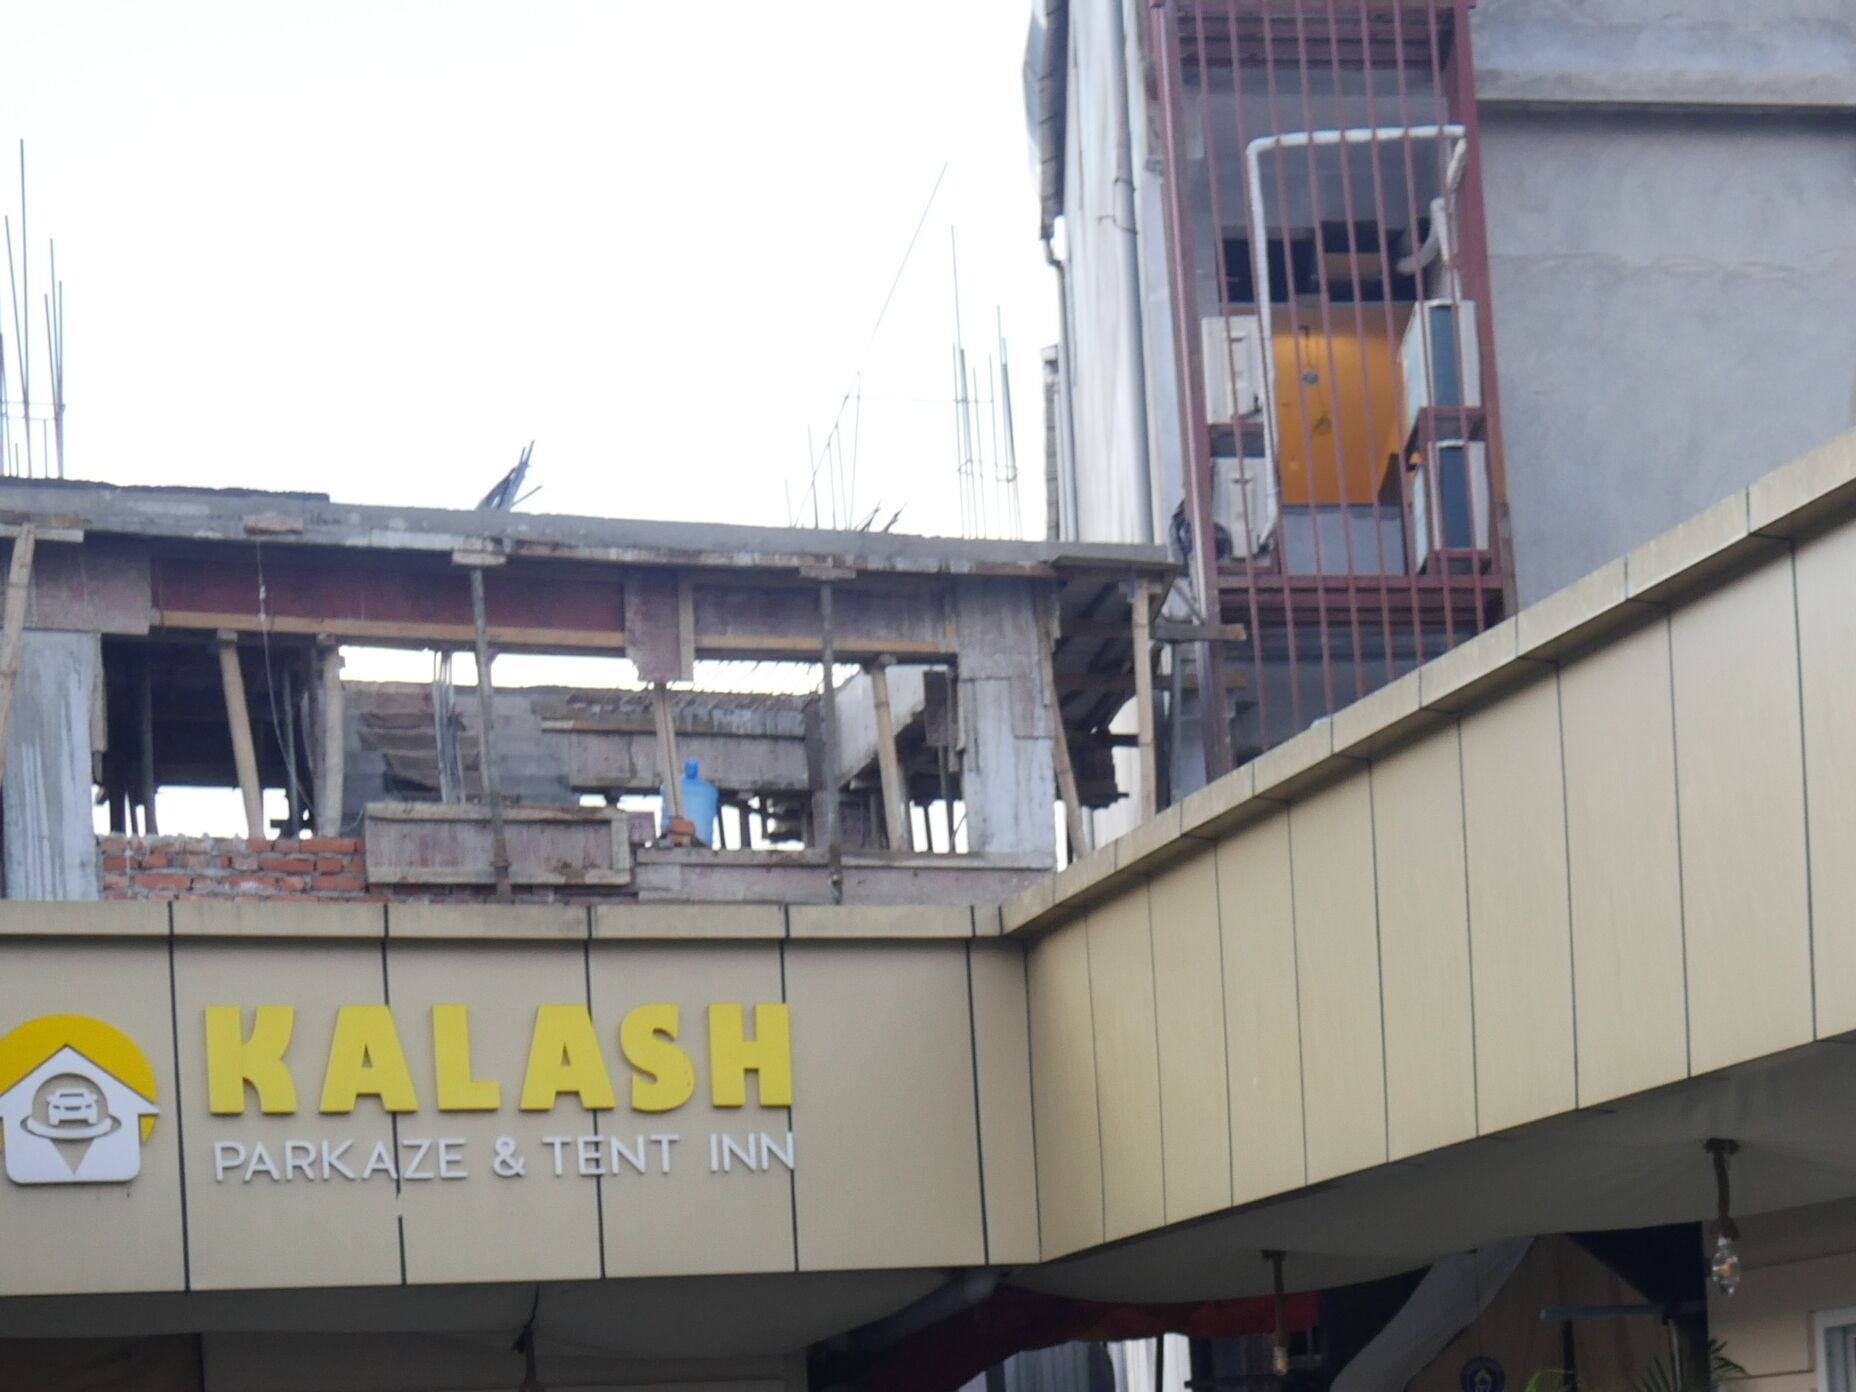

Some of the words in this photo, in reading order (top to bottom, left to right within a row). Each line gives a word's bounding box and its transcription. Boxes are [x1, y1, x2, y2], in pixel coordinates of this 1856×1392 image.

[204, 1003, 794, 1115] KALASH
[215, 1137, 469, 1182] PARKAZE
[493, 1138, 526, 1177] &
[543, 1134, 681, 1176] TENT
[711, 1131, 796, 1171] INN
